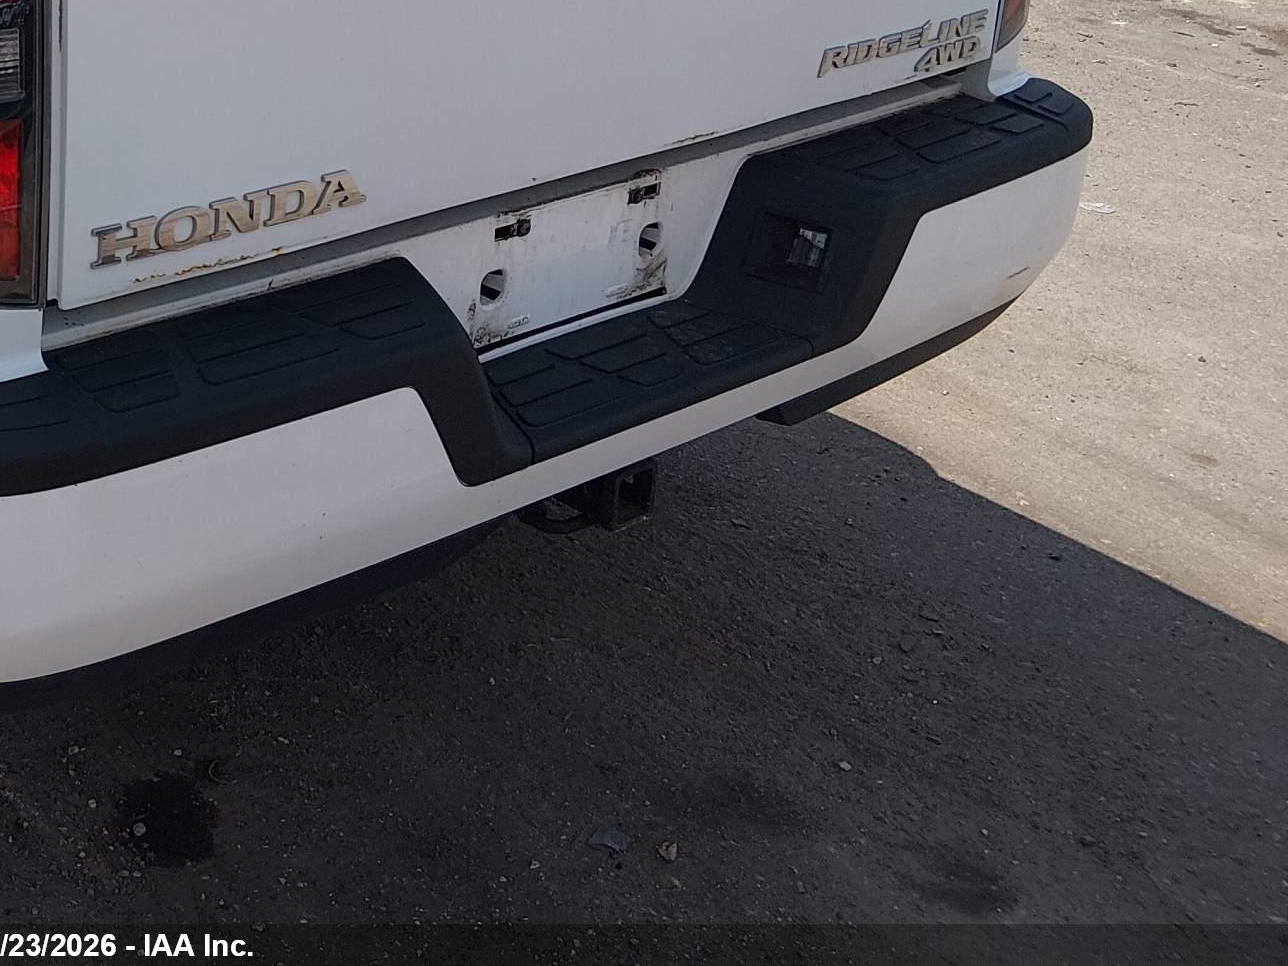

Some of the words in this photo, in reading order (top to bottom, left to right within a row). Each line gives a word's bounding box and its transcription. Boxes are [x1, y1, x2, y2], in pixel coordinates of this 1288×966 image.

[816, 8, 989, 78] RIDGELINE
[914, 35, 981, 73] 4WD
[89, 169, 367, 270] HONDA
